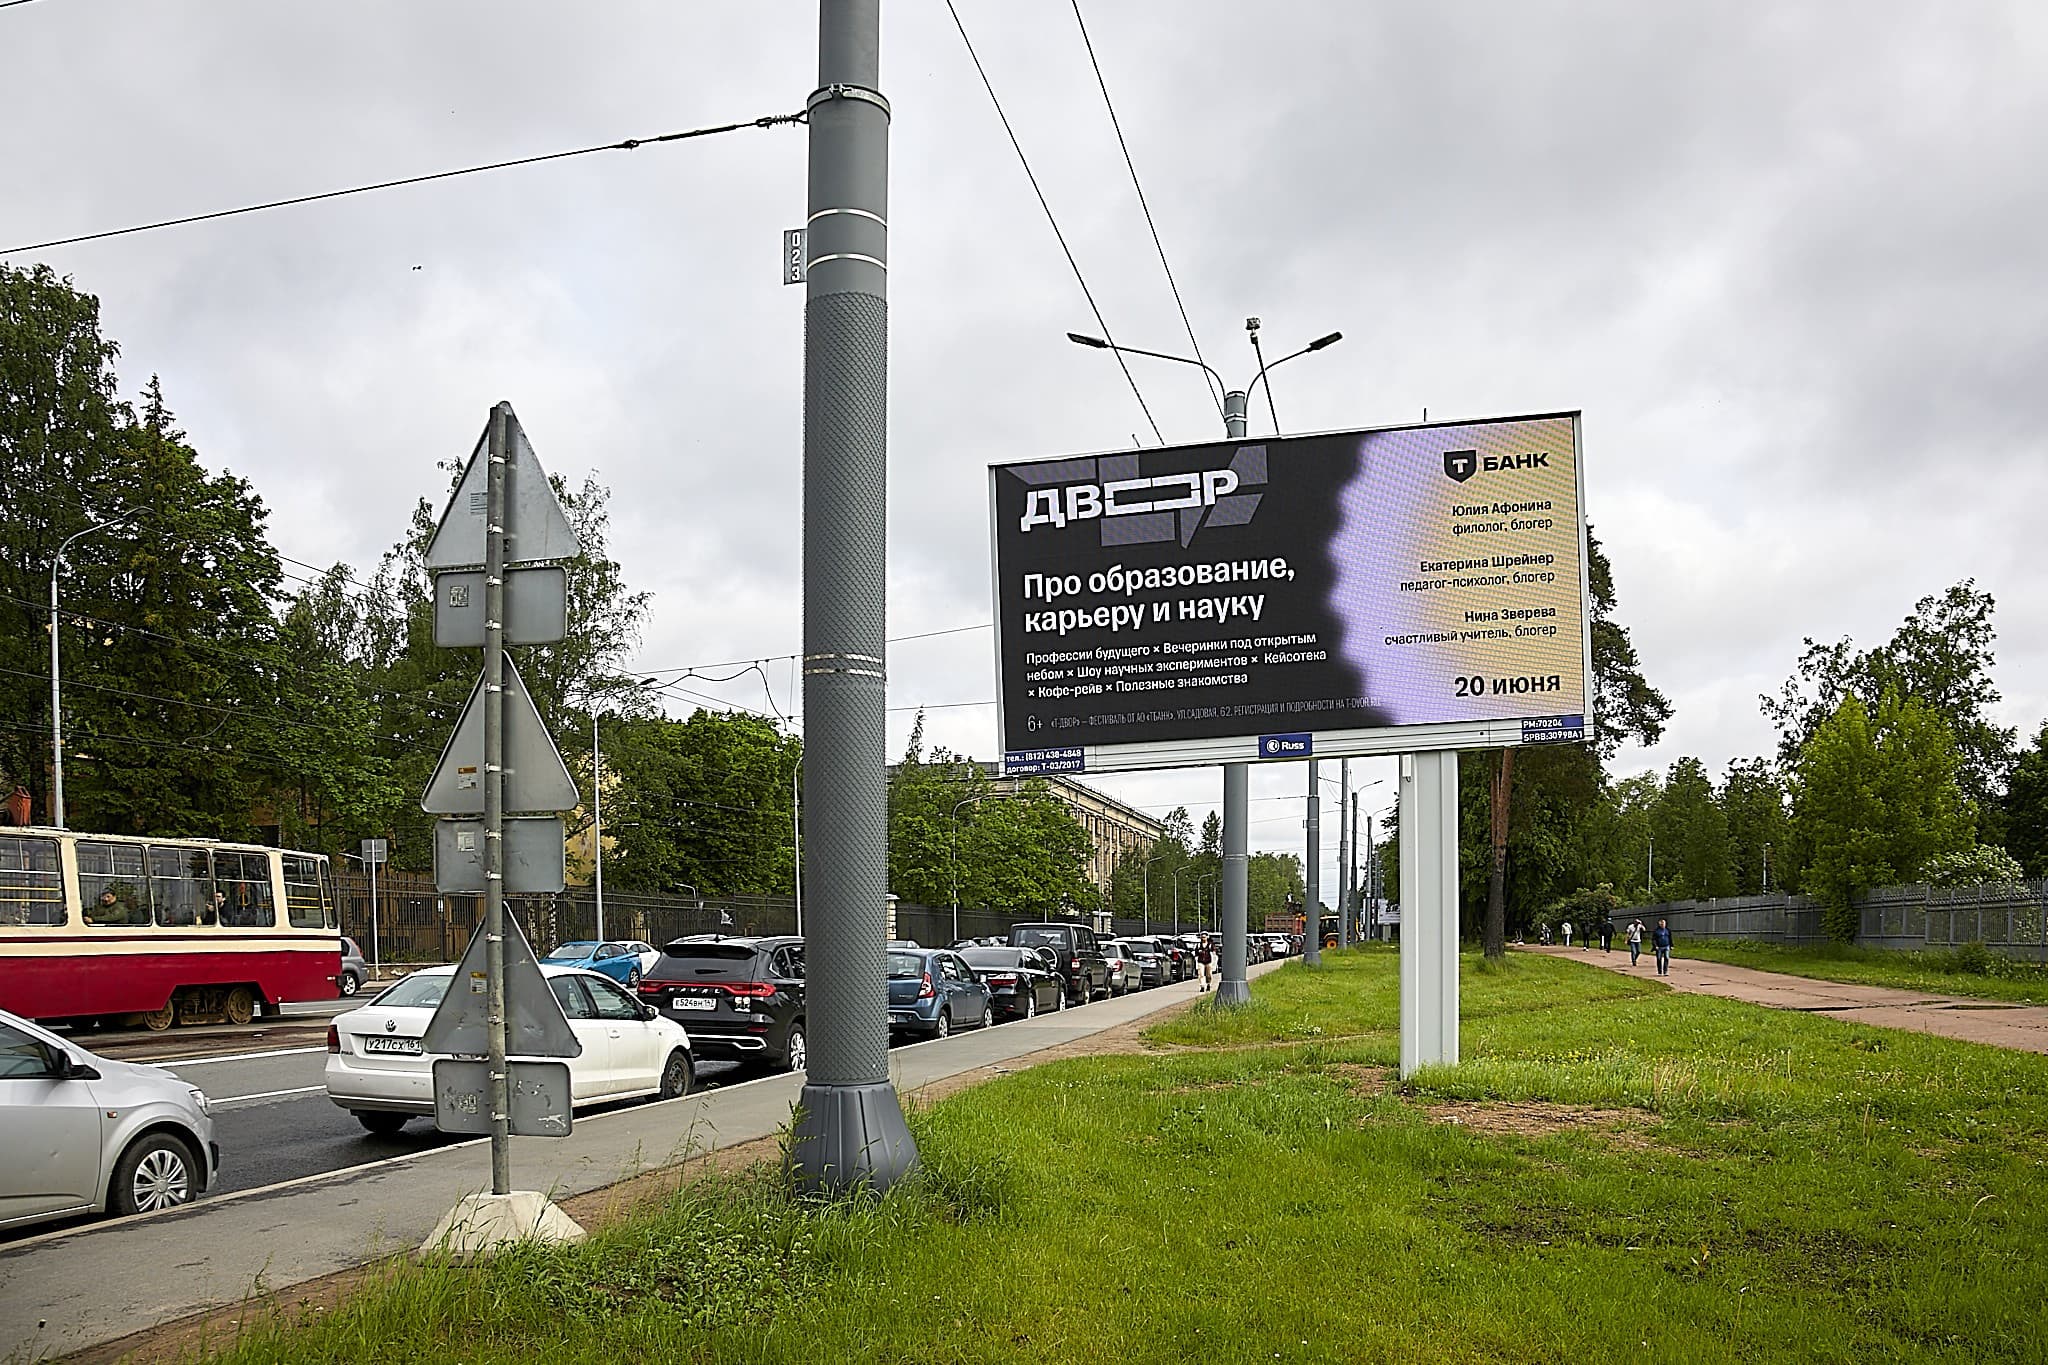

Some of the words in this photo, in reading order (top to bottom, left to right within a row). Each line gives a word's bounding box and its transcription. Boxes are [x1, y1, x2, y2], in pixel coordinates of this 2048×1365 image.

[791, 231, 801, 281] 023
[1483, 452, 1549, 472] БАНК
[1020, 469, 1240, 532] ДВОР
[1452, 503, 1489, 517] Юлия
[1491, 500, 1552, 516] Афонина
[1452, 521, 1508, 537] филолог,
[1510, 518, 1553, 532] блогер
[1420, 557, 1489, 573] Екатерина
[1491, 554, 1554, 570] Шрейнер
[1023, 572, 1082, 603] Про
[1088, 556, 1296, 596] образование,
[1400, 575, 1511, 592] педагог-психолог,
[1512, 571, 1555, 586] блогер
[1024, 602, 1146, 636] карьеру
[1152, 601, 1170, 622] и
[1178, 594, 1265, 625] науку
[1464, 608, 1499, 623] Нина
[1501, 607, 1556, 621] Зверева
[1385, 630, 1458, 646] счастливый
[1459, 628, 1513, 644] учитель,
[1514, 624, 1557, 639] блогер
[1026, 650, 1093, 667] Профессии
[1095, 646, 1151, 662] будущего
[1163, 641, 1228, 655] Вечеринки
[1230, 638, 1252, 650] под
[1254, 633, 1317, 649] открытым
[1026, 668, 1064, 682] небом
[1077, 666, 1101, 680] Шоу
[1104, 661, 1154, 678] научных
[1156, 656, 1248, 672] экспериментов
[1264, 649, 1327, 664] Кейсотека
[1038, 682, 1103, 699] Кофе-рейв
[1115, 678, 1175, 693] Полезные
[1177, 673, 1249, 688] знакомства
[1454, 675, 1485, 698] 20
[1492, 675, 1561, 695] июня
[1027, 715, 1043, 732] 6+
[1088, 713, 1127, 726] ФЕСТИВАЛЬ
[1234, 702, 1279, 716] РЕГИСТРАЦИЯ
[1286, 699, 1334, 713] ПОДРОБНОСТИ
[1006, 755, 1024, 763] тел.:
[1025, 751, 1044, 762] (812)
[1281, 741, 1305, 751] Russ
[1006, 764, 1041, 775] договор:
[1041, 759, 1081, 770] Т-03/2017
